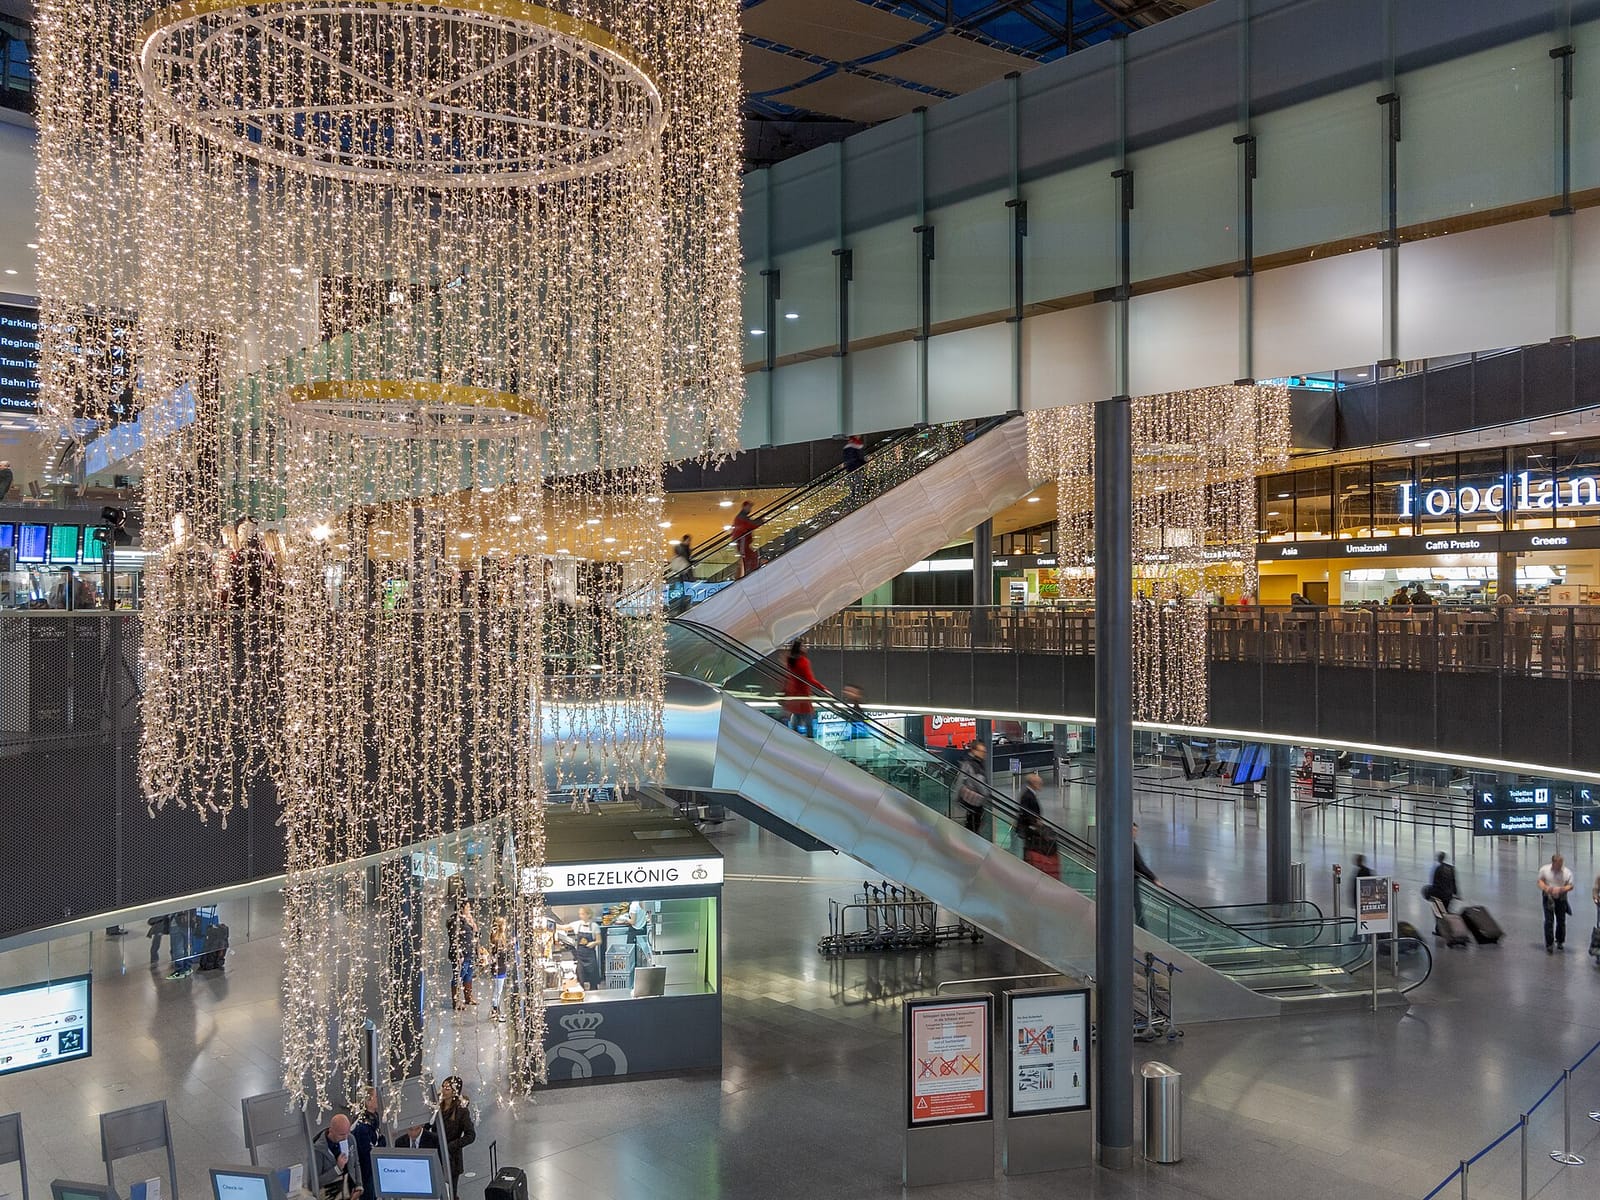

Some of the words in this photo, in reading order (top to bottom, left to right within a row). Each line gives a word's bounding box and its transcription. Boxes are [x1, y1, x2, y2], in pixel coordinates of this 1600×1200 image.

[1, 317, 38, 330] Parking
[1, 337, 41, 351] Regiona
[1425, 541, 1449, 551] Caffè
[1450, 539, 1480, 549] Presto
[1531, 536, 1568, 546] Greens
[1281, 547, 1299, 556] Asia
[1346, 543, 1388, 553] Umaizushi
[566, 866, 679, 887] BREZELKÖNIG
[34, 1034, 52, 1044] LOT
